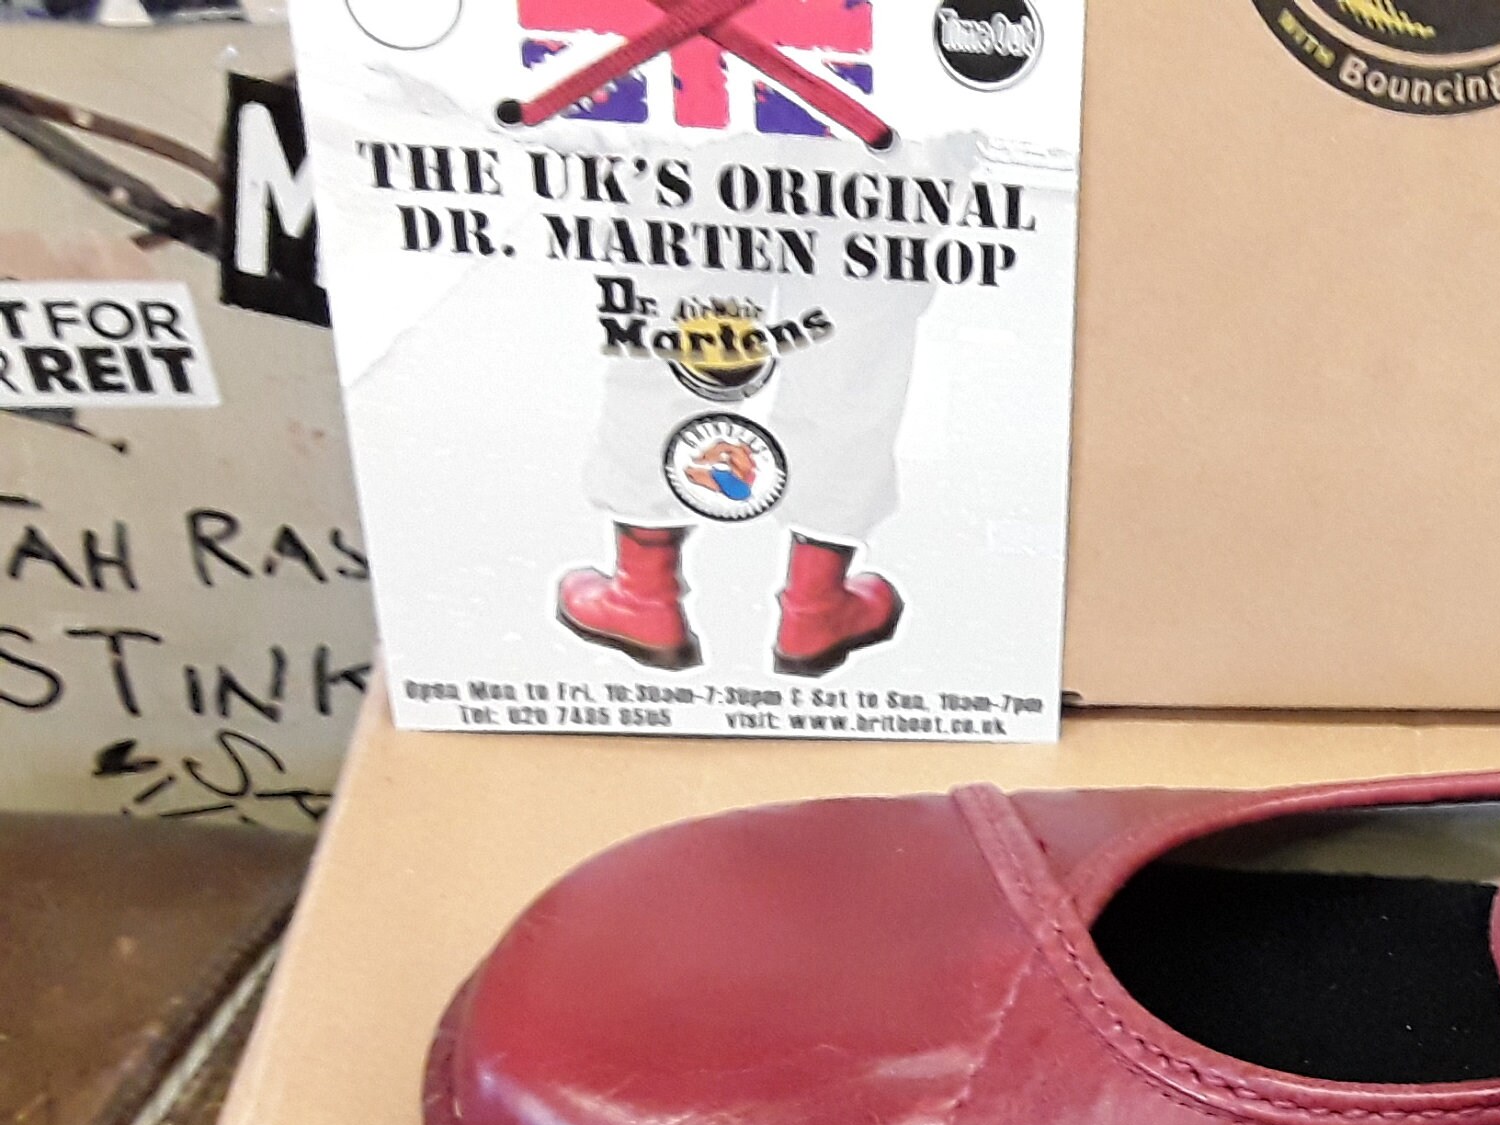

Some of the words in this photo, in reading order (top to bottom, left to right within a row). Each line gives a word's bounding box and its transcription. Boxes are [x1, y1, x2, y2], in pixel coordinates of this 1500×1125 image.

[355, 140, 504, 197] THE
[526, 148, 693, 208] UK'S
[717, 163, 1037, 232] ORIGINAL
[397, 203, 517, 257] DR.
[542, 212, 818, 277] MARTEN
[843, 233, 1018, 287] SHOP
[43, 301, 186, 341] FOR
[599, 306, 836, 358] Martens
[466, 681, 517, 702] Mon
[523, 683, 550, 701] to
[811, 687, 848, 708] Sat
[856, 690, 879, 708] to
